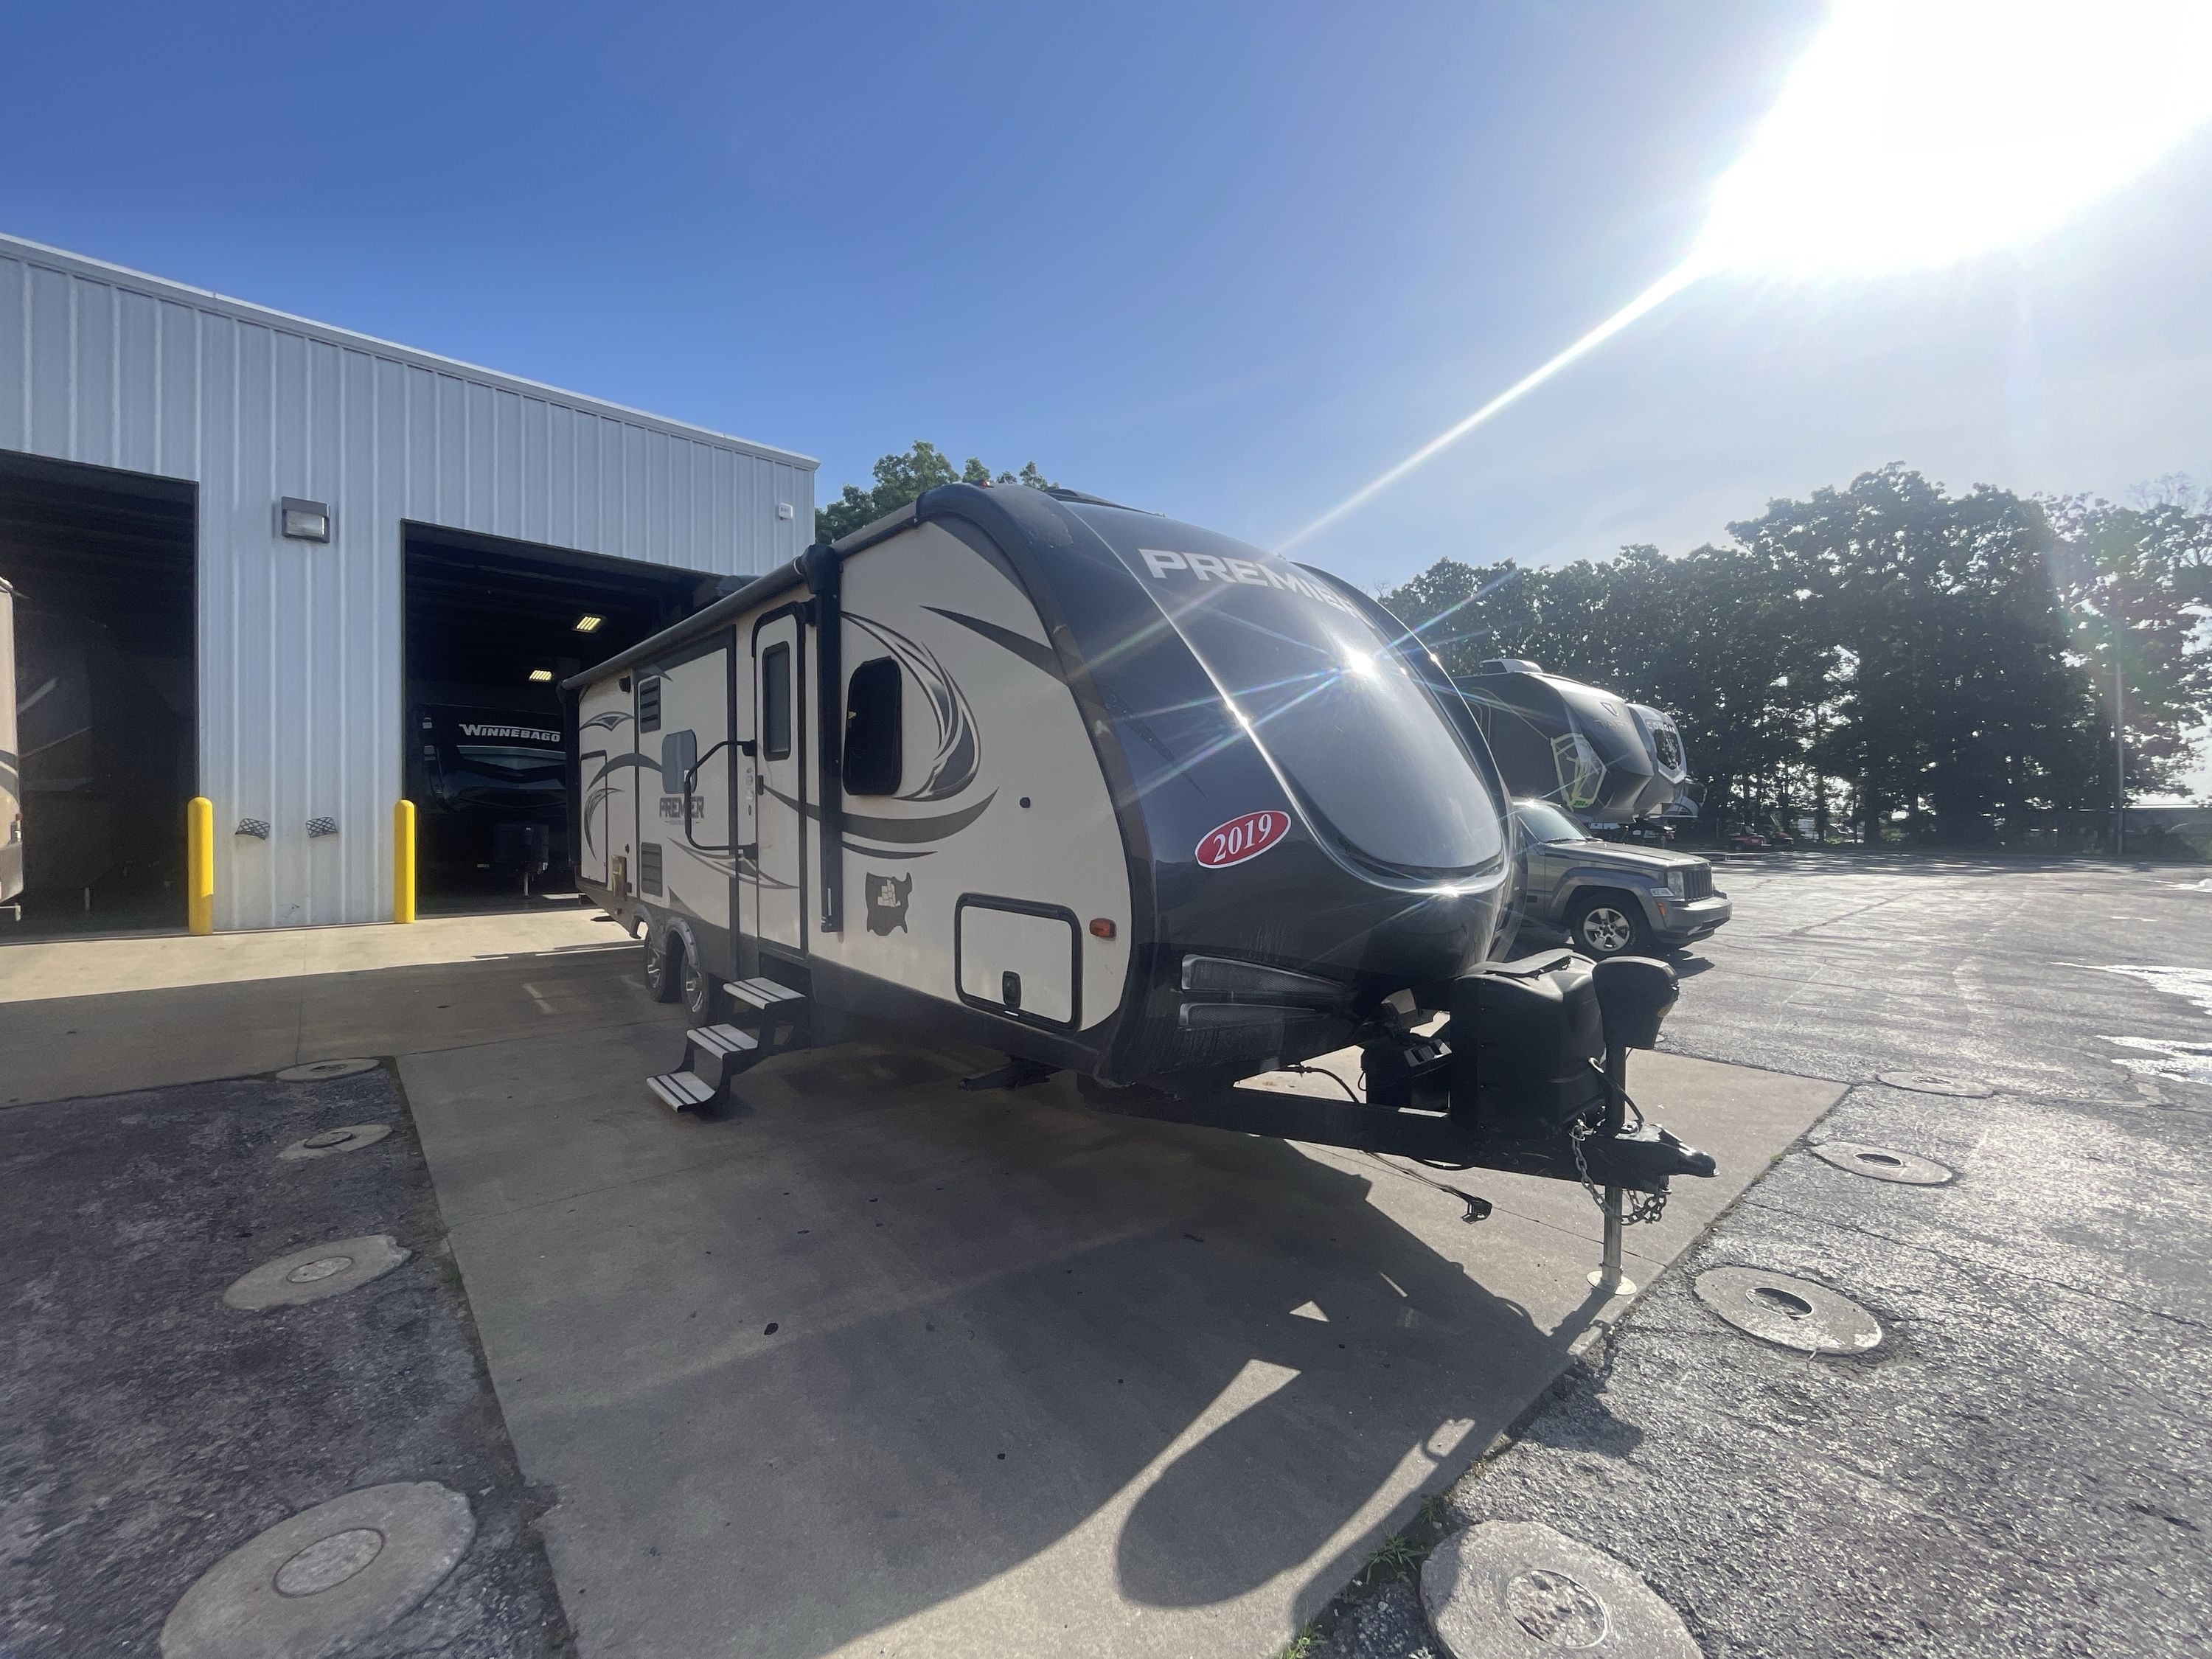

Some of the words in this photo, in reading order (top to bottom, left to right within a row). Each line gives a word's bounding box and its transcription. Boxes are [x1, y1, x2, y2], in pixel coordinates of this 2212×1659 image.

[1138, 548, 1375, 629] PREMIER
[659, 796, 705, 818] PREMER
[1213, 813, 1272, 863] 2019
